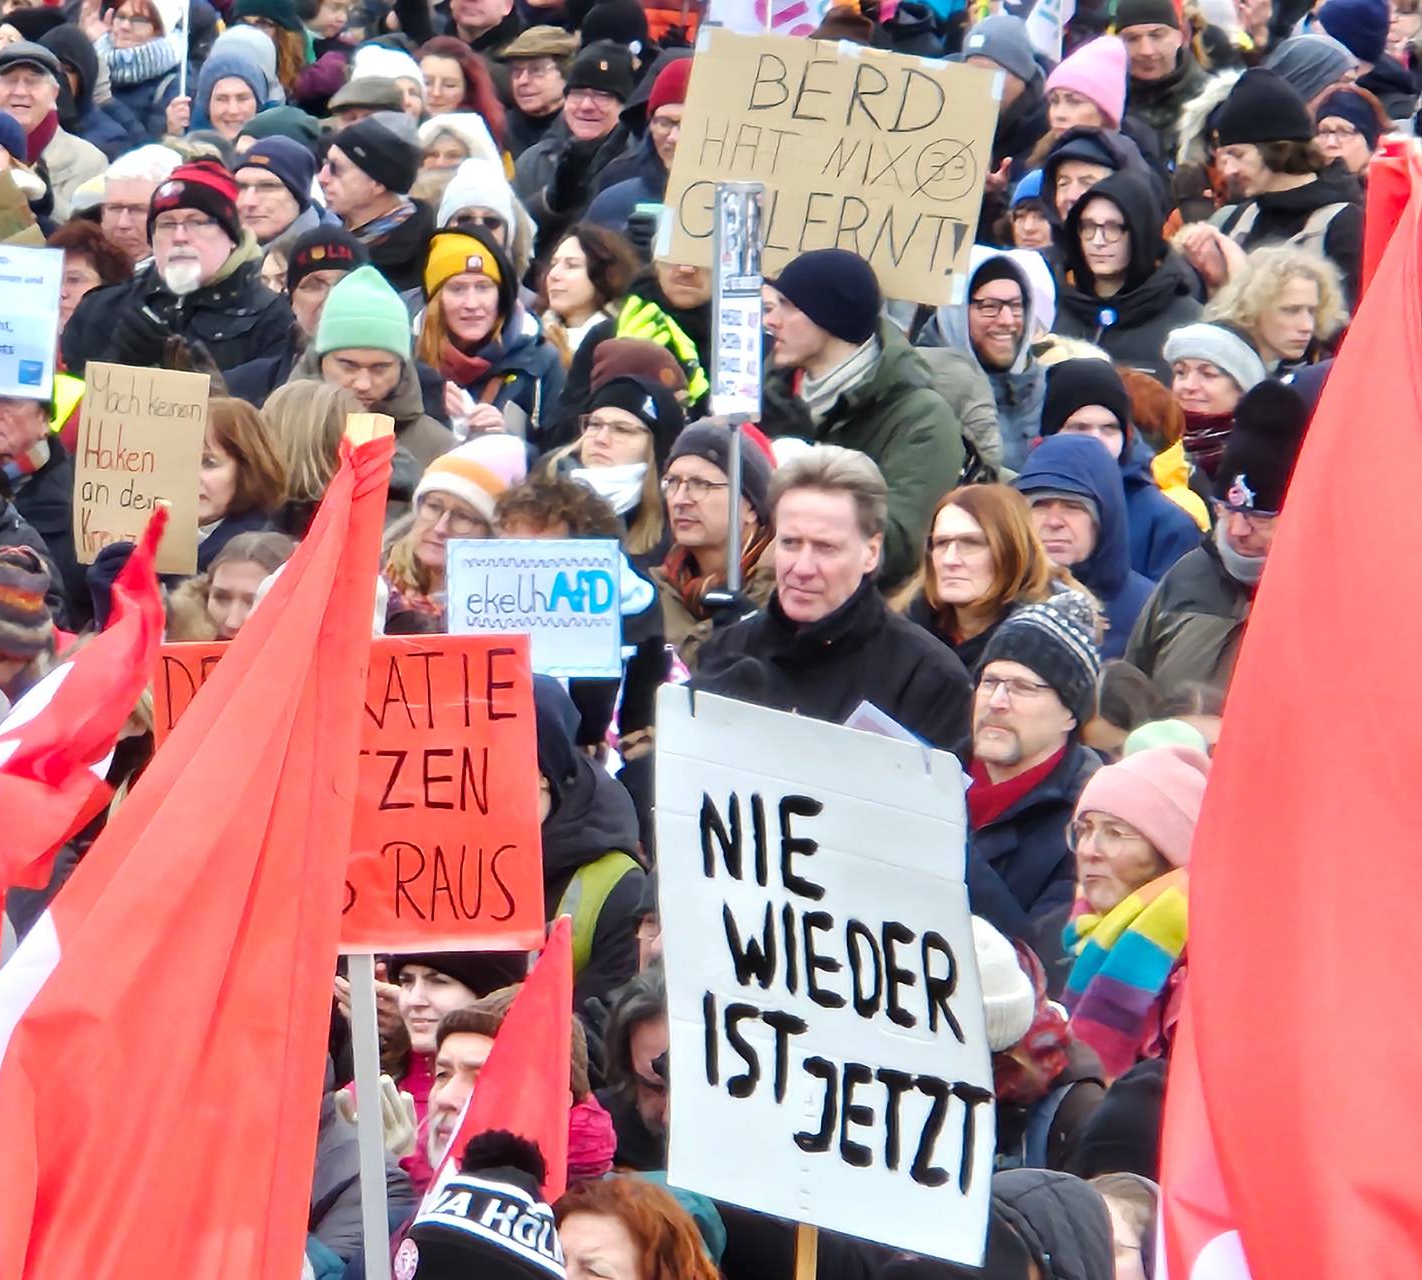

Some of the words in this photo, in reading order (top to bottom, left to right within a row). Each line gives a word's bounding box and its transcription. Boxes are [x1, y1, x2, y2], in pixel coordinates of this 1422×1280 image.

[748, 53, 946, 133] BERD
[699, 117, 802, 175] HAT
[822, 136, 913, 191] NIX
[679, 180, 970, 276] GLERNT!
[90, 369, 140, 416] Mach
[84, 417, 155, 473] Haken
[81, 481, 109, 504] an
[467, 570, 615, 615] ekelhAfD
[381, 841, 517, 921] RAUS
[699, 790, 825, 901] NIE
[722, 899, 966, 1044] WIEDER
[703, 990, 809, 1104] IST
[793, 1054, 994, 1197] JETZT
